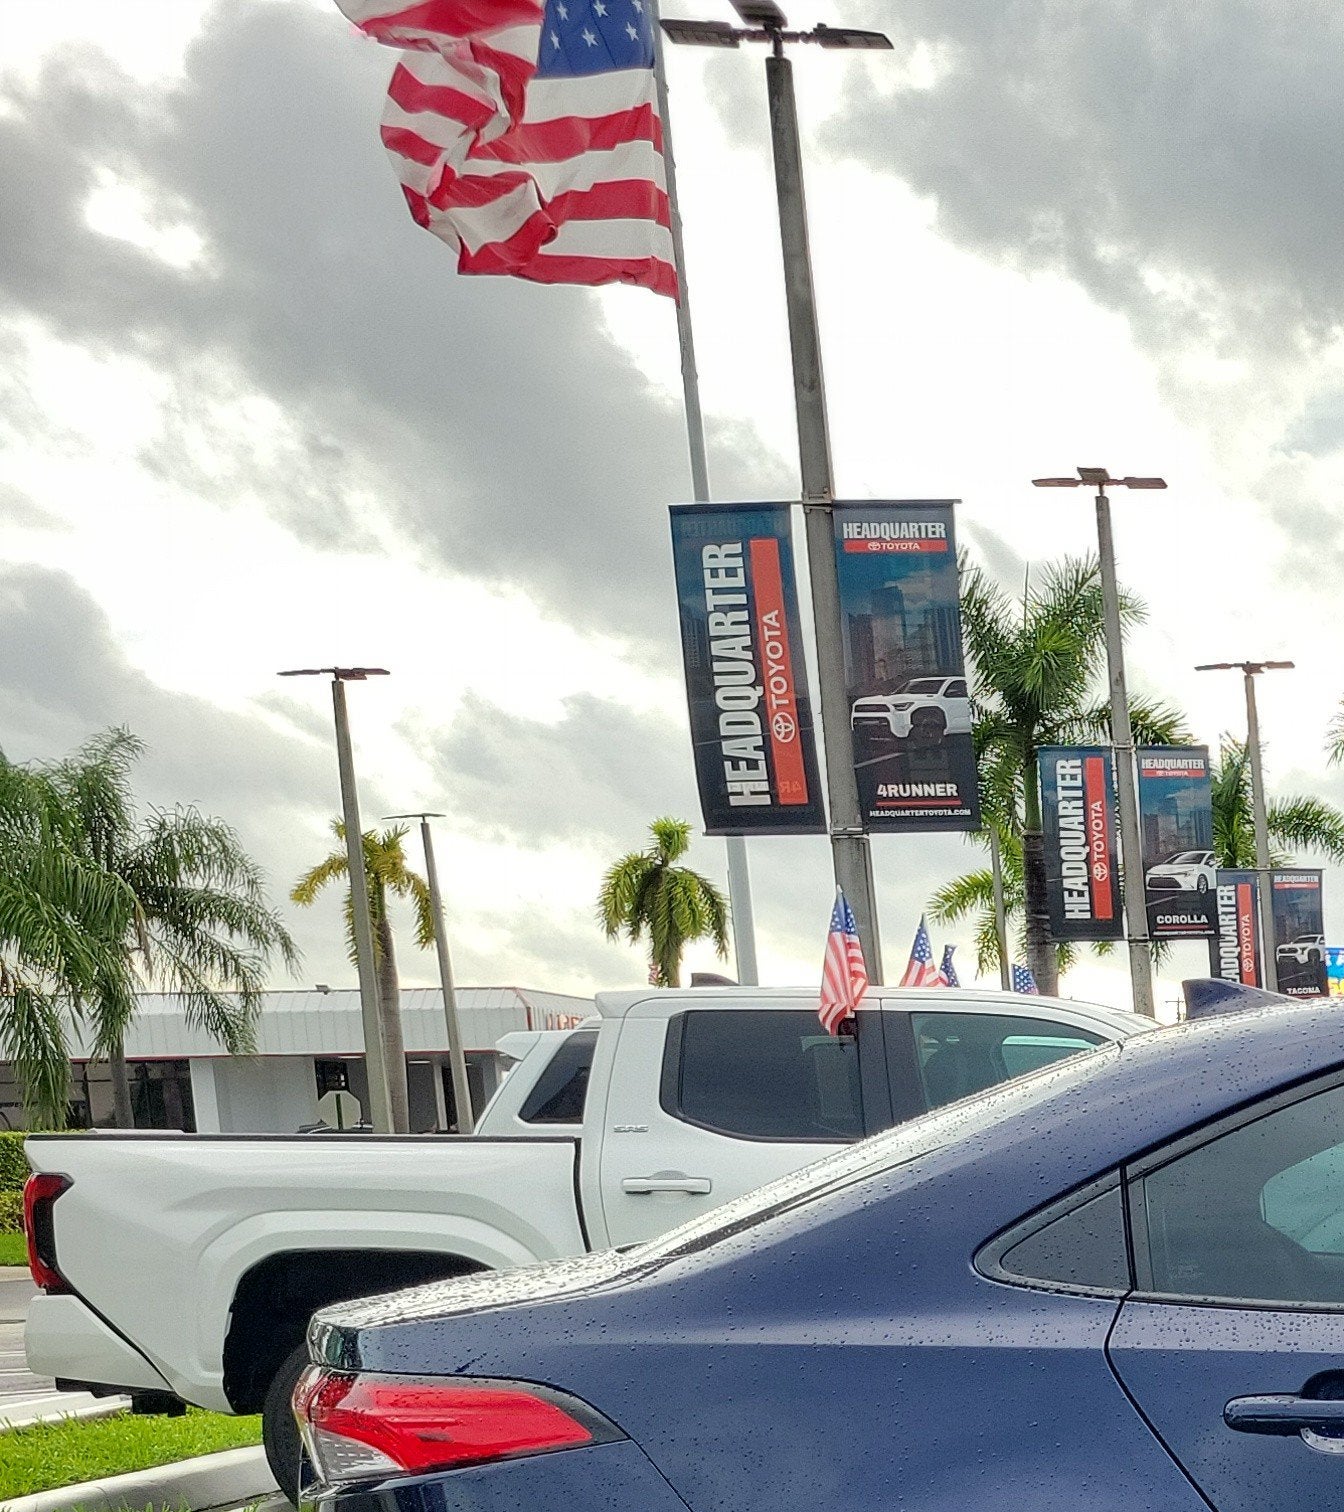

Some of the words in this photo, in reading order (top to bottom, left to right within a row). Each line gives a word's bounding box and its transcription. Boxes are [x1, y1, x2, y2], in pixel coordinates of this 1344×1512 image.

[843, 522, 947, 541] HEADQUARTER
[881, 542, 920, 550] TOYOTA
[702, 541, 772, 806] HEADQUARTER
[762, 610, 788, 708] TOYOTA
[1141, 758, 1205, 770] HEADQUARTER
[877, 783, 959, 797] 4RUNNER
[1056, 758, 1092, 919] HEADQUARTER
[1090, 800, 1106, 861] TOYOTA
[1156, 914, 1209, 924] COROLLA
[1216, 884, 1240, 984] ADQUARTER
[1242, 914, 1251, 958] TOYOTA
[1286, 986, 1321, 995] TACOMA
